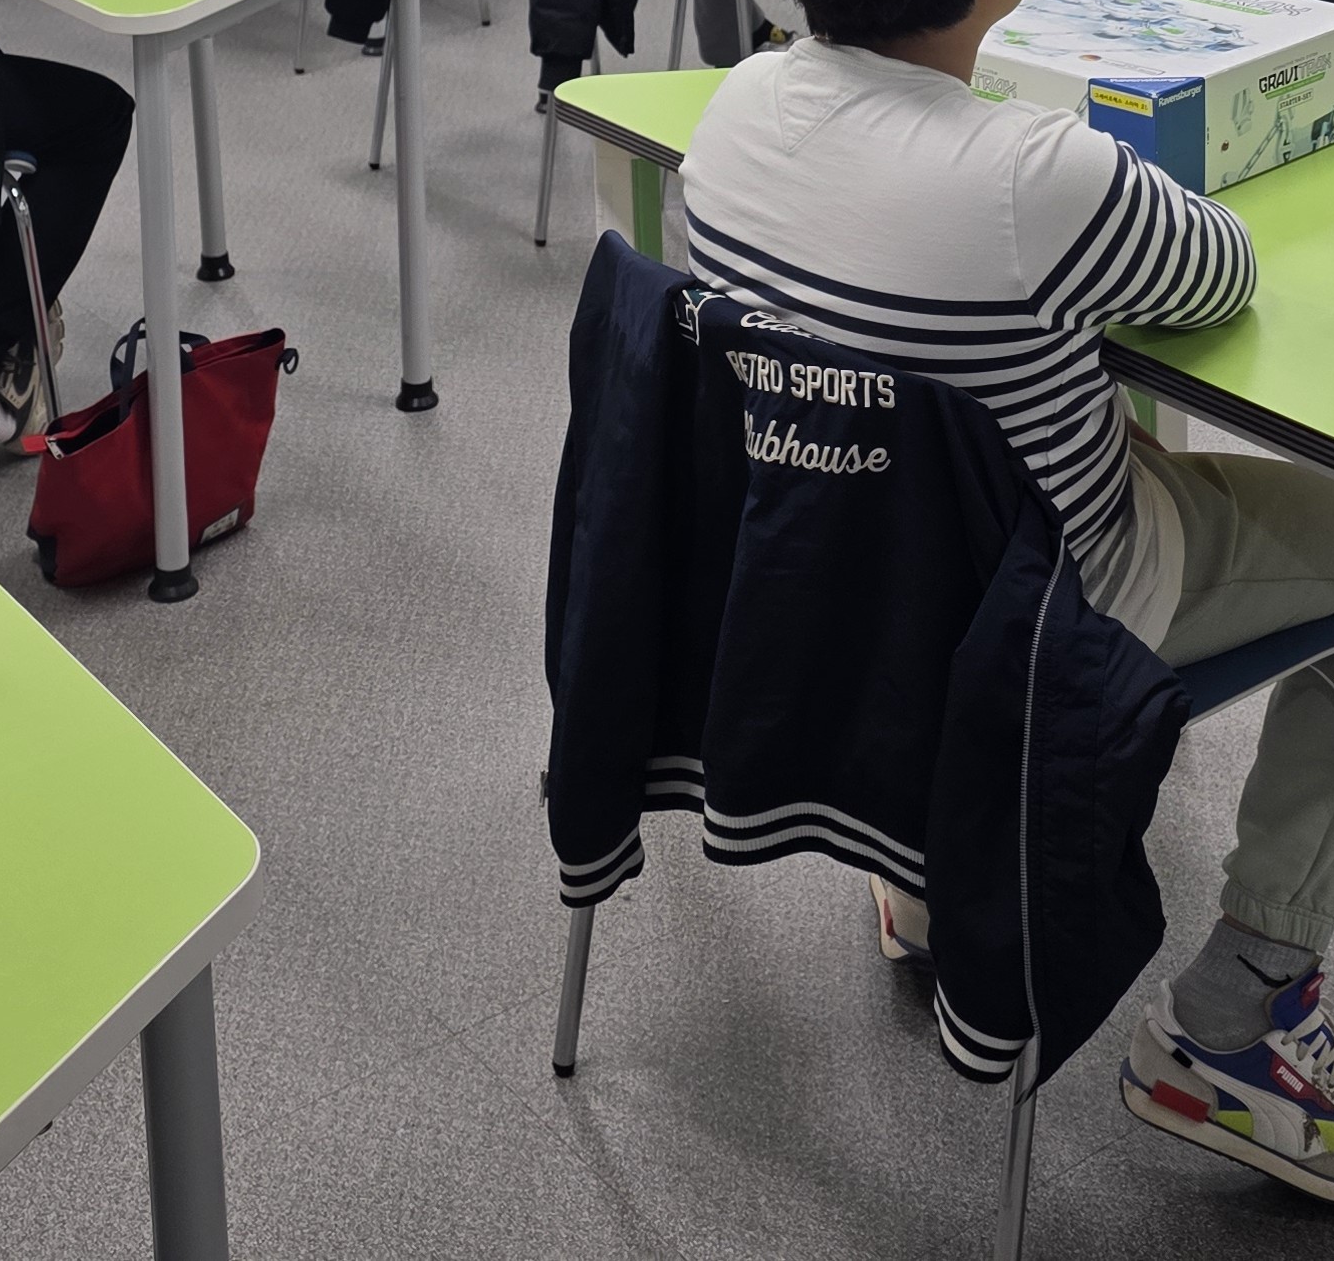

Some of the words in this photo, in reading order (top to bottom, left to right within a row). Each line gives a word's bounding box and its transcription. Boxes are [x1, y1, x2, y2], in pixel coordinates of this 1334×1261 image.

[1258, 52, 1332, 93] GRAVITRAX
[1158, 84, 1203, 108] Ravensburger
[725, 350, 784, 394] RETRO
[790, 363, 896, 409] SPORTS
[1276, 1065, 1304, 1093] PUMA
